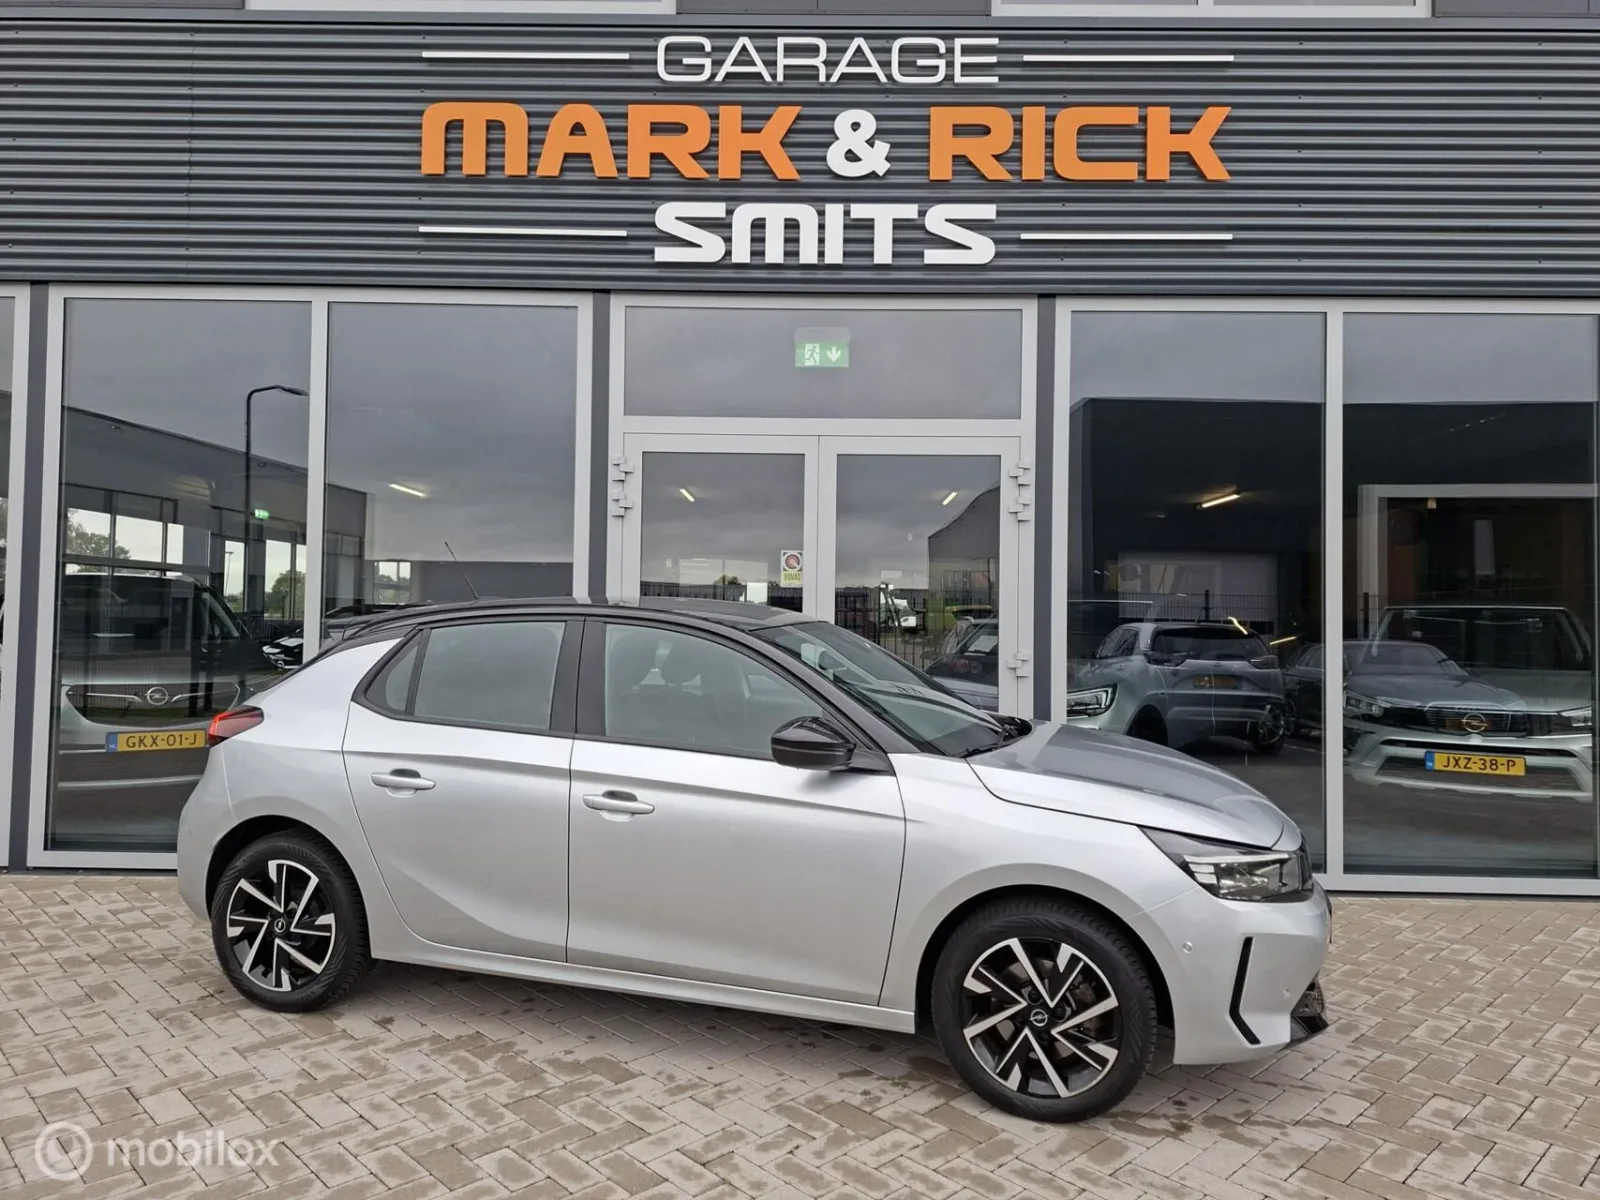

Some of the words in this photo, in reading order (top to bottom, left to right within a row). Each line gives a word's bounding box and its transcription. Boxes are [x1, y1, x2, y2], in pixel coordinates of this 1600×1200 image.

[655, 36, 1000, 84] GARAGE
[420, 101, 802, 181] MARK
[826, 109, 892, 178] &
[928, 105, 1233, 182] RICK
[653, 202, 998, 265] SMITS
[125, 732, 198, 749] GKX-01-J
[1442, 755, 1517, 773] JXZ-38-P
